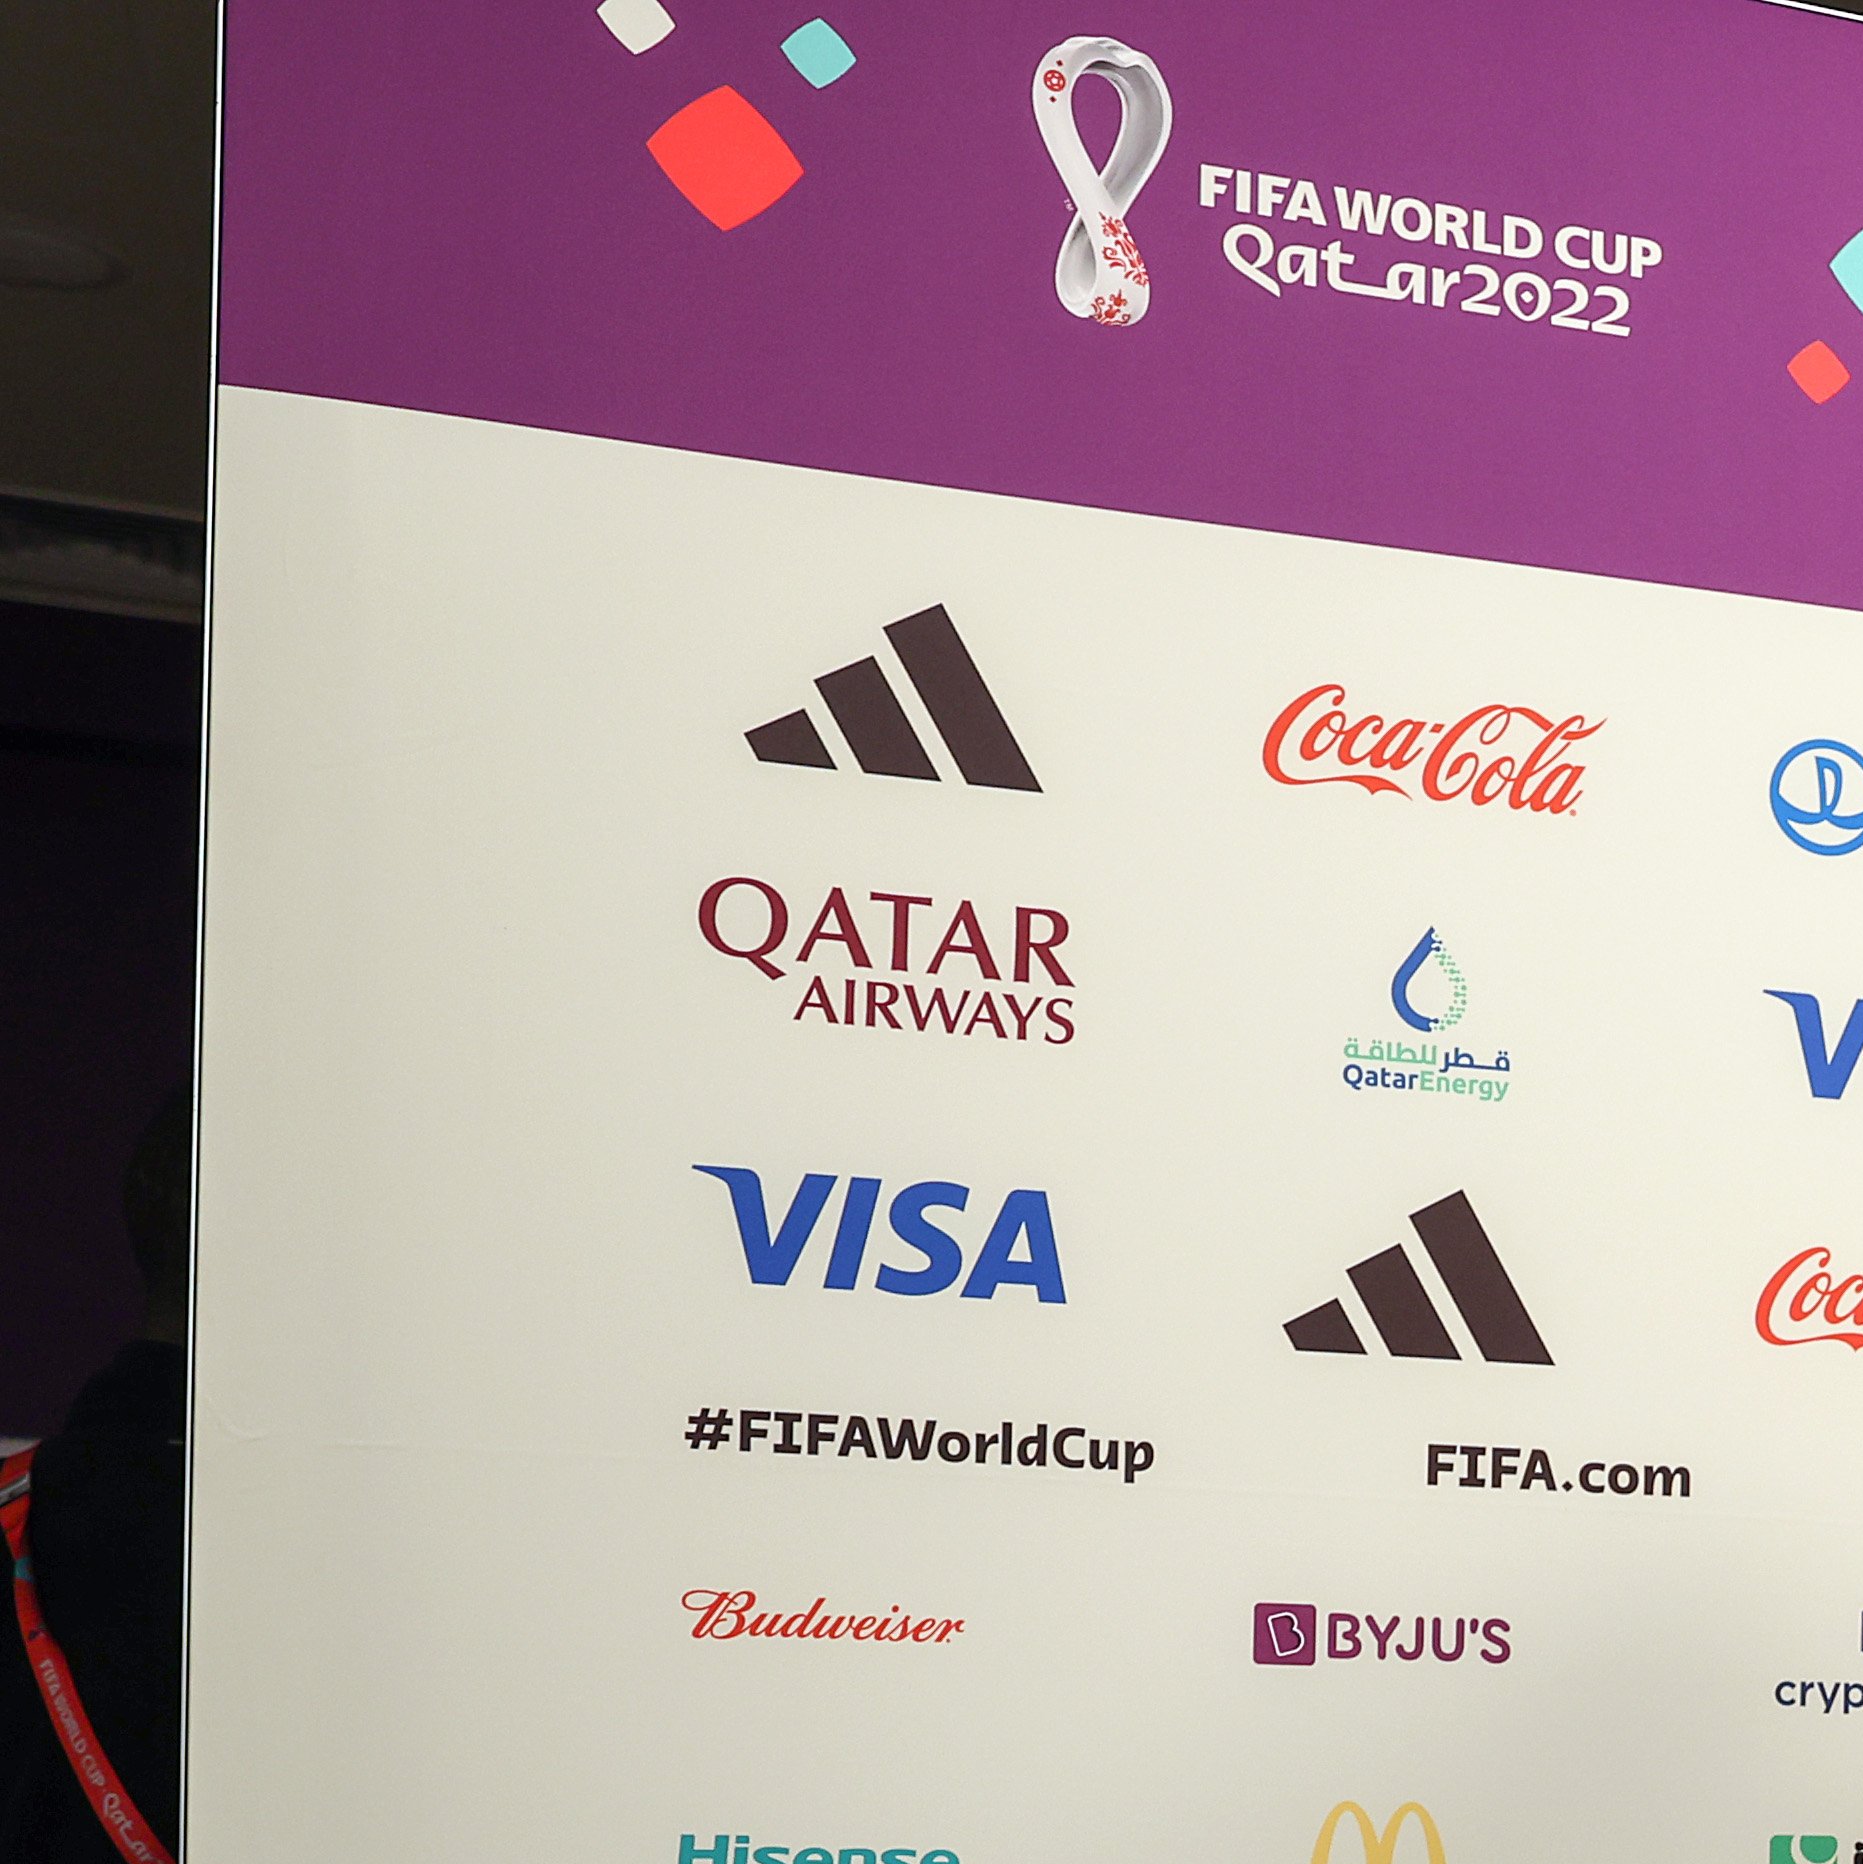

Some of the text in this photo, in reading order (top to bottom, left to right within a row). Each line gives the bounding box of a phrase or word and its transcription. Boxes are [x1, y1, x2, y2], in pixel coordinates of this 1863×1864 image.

[1198, 162, 1663, 279] FIFA WORLD CUP
[1262, 684, 1607, 816] Coca-Cola
[698, 877, 1076, 988] QATAR
[793, 975, 1074, 1045] AIRWAYS
[1343, 1063, 1510, 1102] QatarEnergy
[692, 1164, 1067, 1304] VISA
[684, 1408, 1155, 1484] #FIFAWorldCup
[1427, 1444, 1691, 1498] FIFA.com
[681, 1590, 965, 1643] Budweiser
[1327, 1613, 1511, 1664] BYJU'S
[54, 1693, 87, 1754] WORLD
[82, 1755, 105, 1787] CUP
